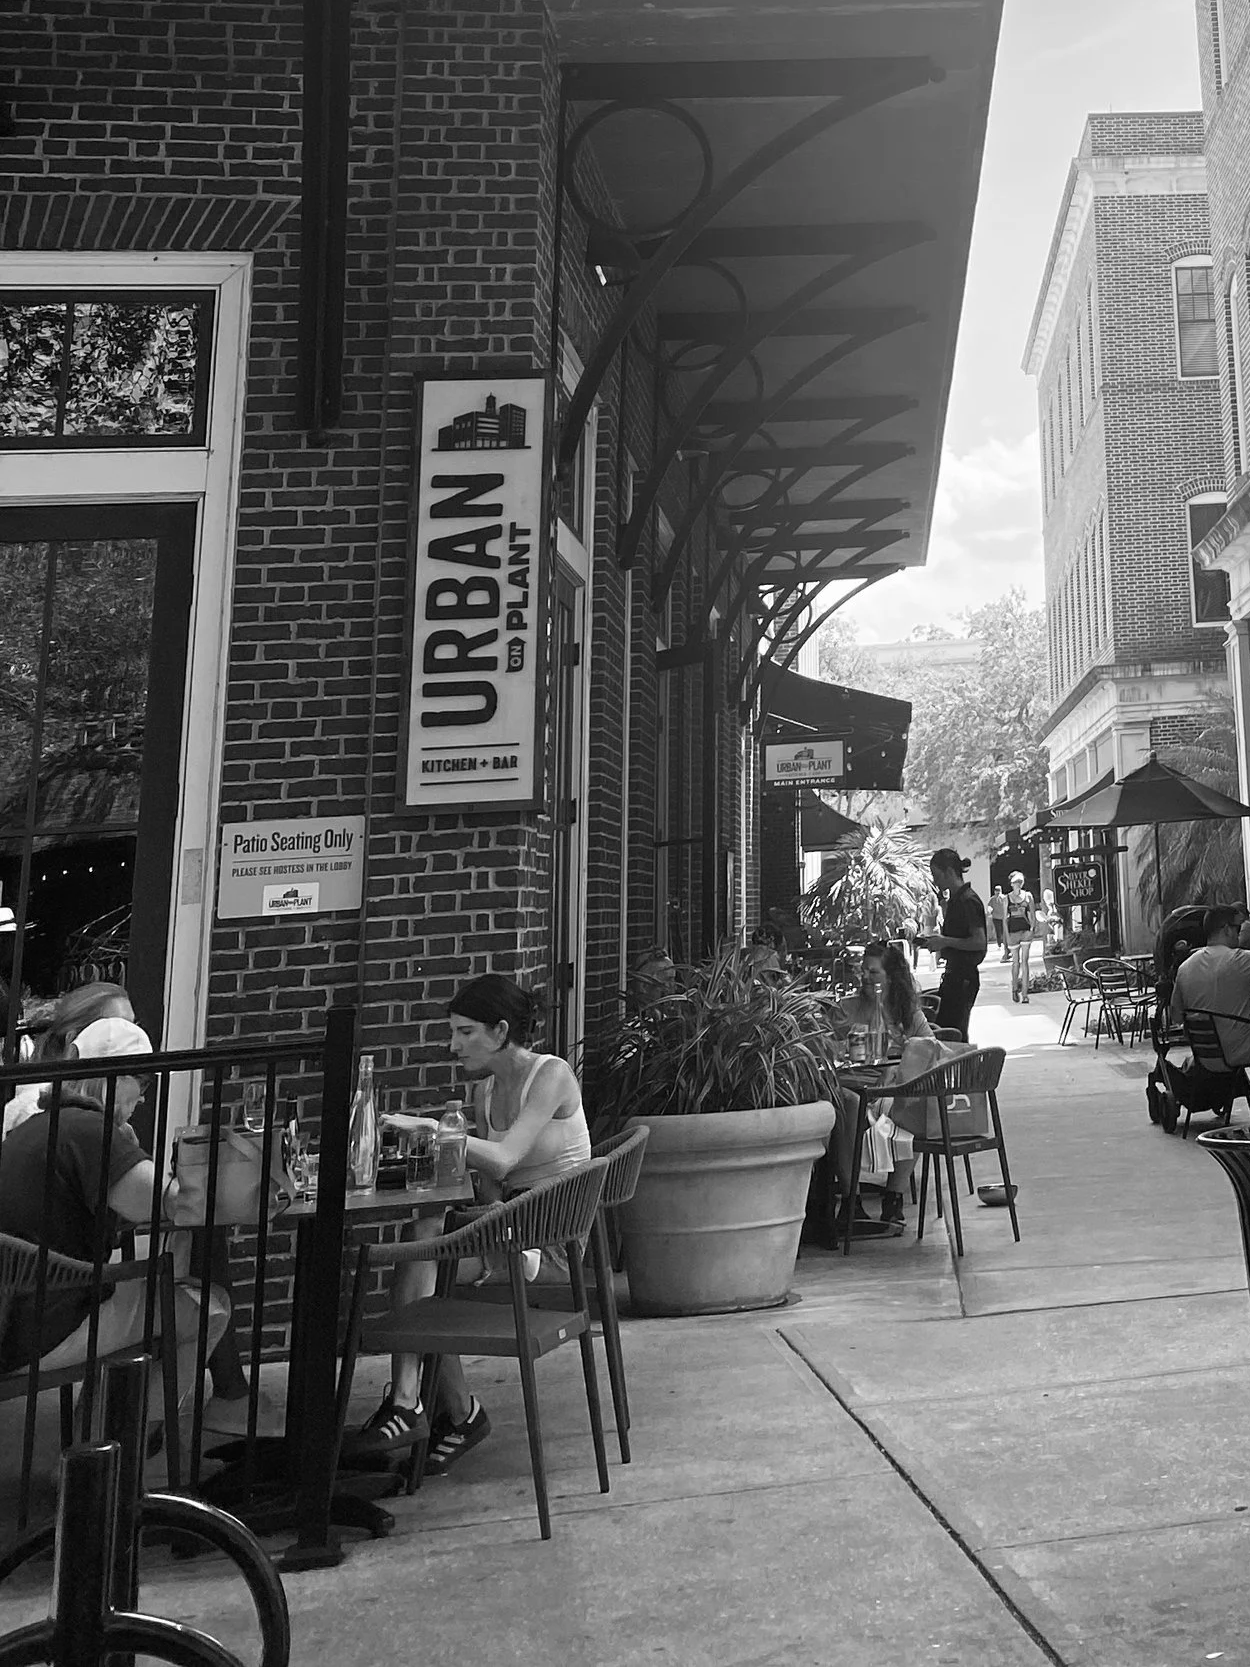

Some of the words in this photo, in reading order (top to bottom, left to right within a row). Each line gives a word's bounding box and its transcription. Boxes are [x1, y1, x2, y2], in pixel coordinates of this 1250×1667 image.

[506, 521, 531, 631] PLANT
[420, 473, 505, 728] URBAN
[510, 644, 522, 668] ON
[421, 757, 477, 773] KITCHEN
[492, 755, 518, 770] BAR
[776, 761, 801, 773] URBAN
[808, 759, 833, 771] PLANT
[795, 777, 836, 785] ENTRANCE
[233, 834, 268, 854] Patio
[270, 831, 322, 854] Seating
[324, 828, 354, 852] Only
[231, 867, 258, 878] PLEASE
[259, 865, 272, 876] SEE
[273, 863, 305, 875] HOSTESS
[306, 863, 315, 873] IN
[315, 862, 329, 873] THE
[330, 861, 353, 871] LOBBY
[1070, 887, 1095, 900] SHOP
[268, 898, 289, 909] URBAN
[293, 897, 313, 907] PLANT
